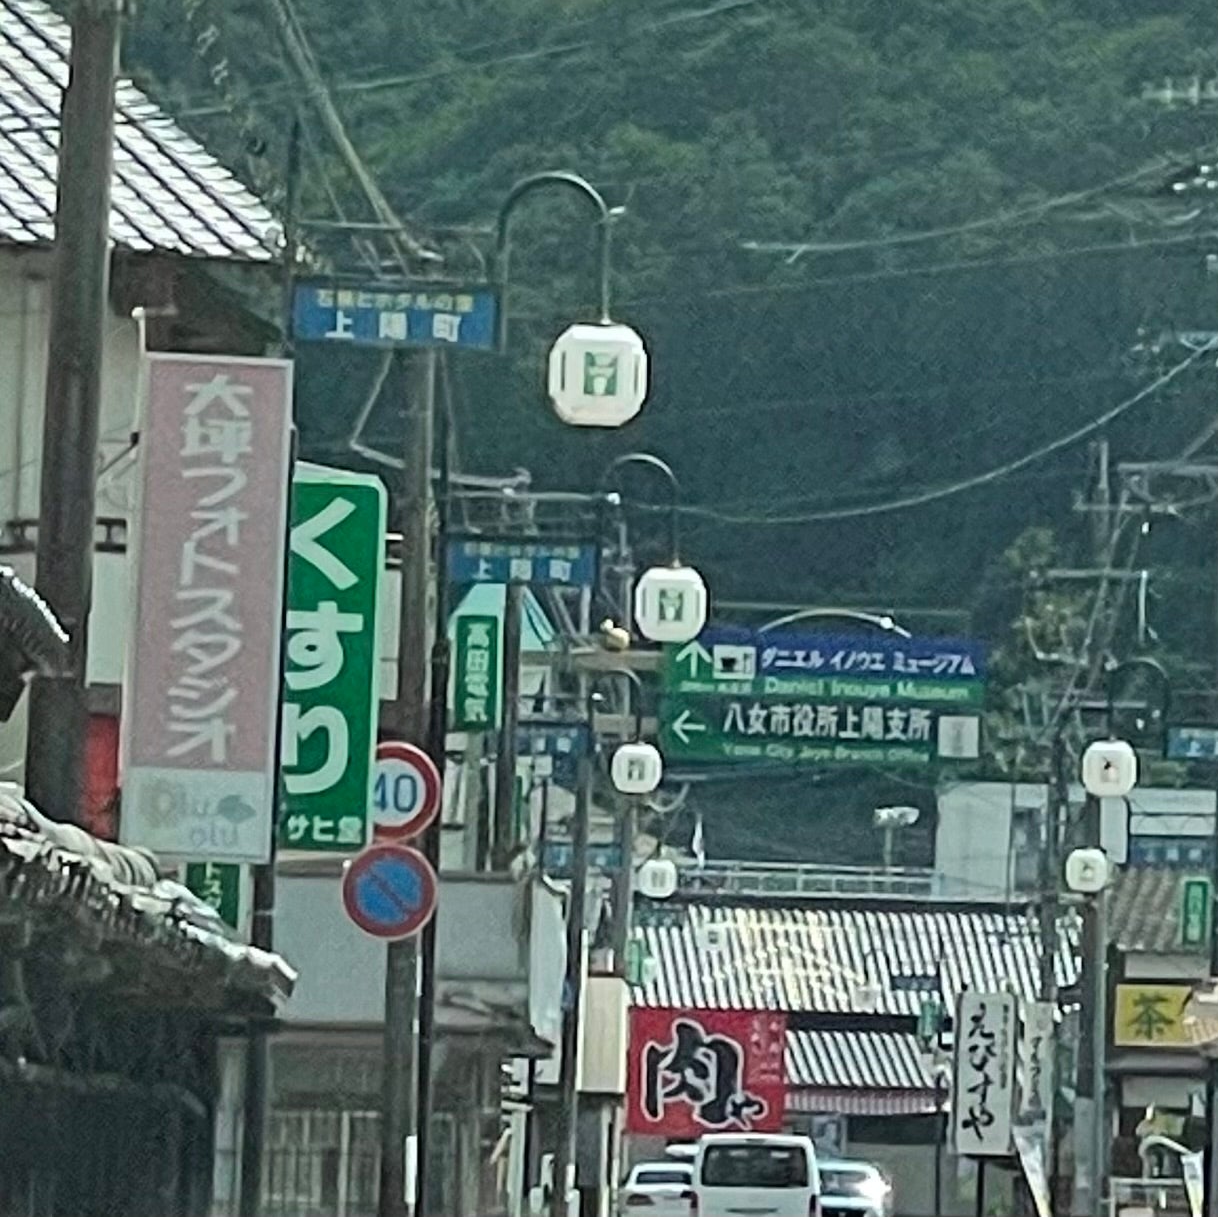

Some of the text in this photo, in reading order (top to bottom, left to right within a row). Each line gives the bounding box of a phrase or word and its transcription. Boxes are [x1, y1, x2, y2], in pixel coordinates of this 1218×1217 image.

[284, 495, 364, 795] くすり
[761, 647, 976, 675] ダニエル イノウエ ミュージアム
[764, 676, 824, 695] Daniel
[831, 680, 891, 699] Inouye
[897, 681, 969, 700] Museum
[723, 702, 931, 742] 八女市役所上陽支所
[373, 773, 418, 814] 40
[1128, 992, 1176, 1040] 茶
[961, 1002, 997, 1142] えびすや
